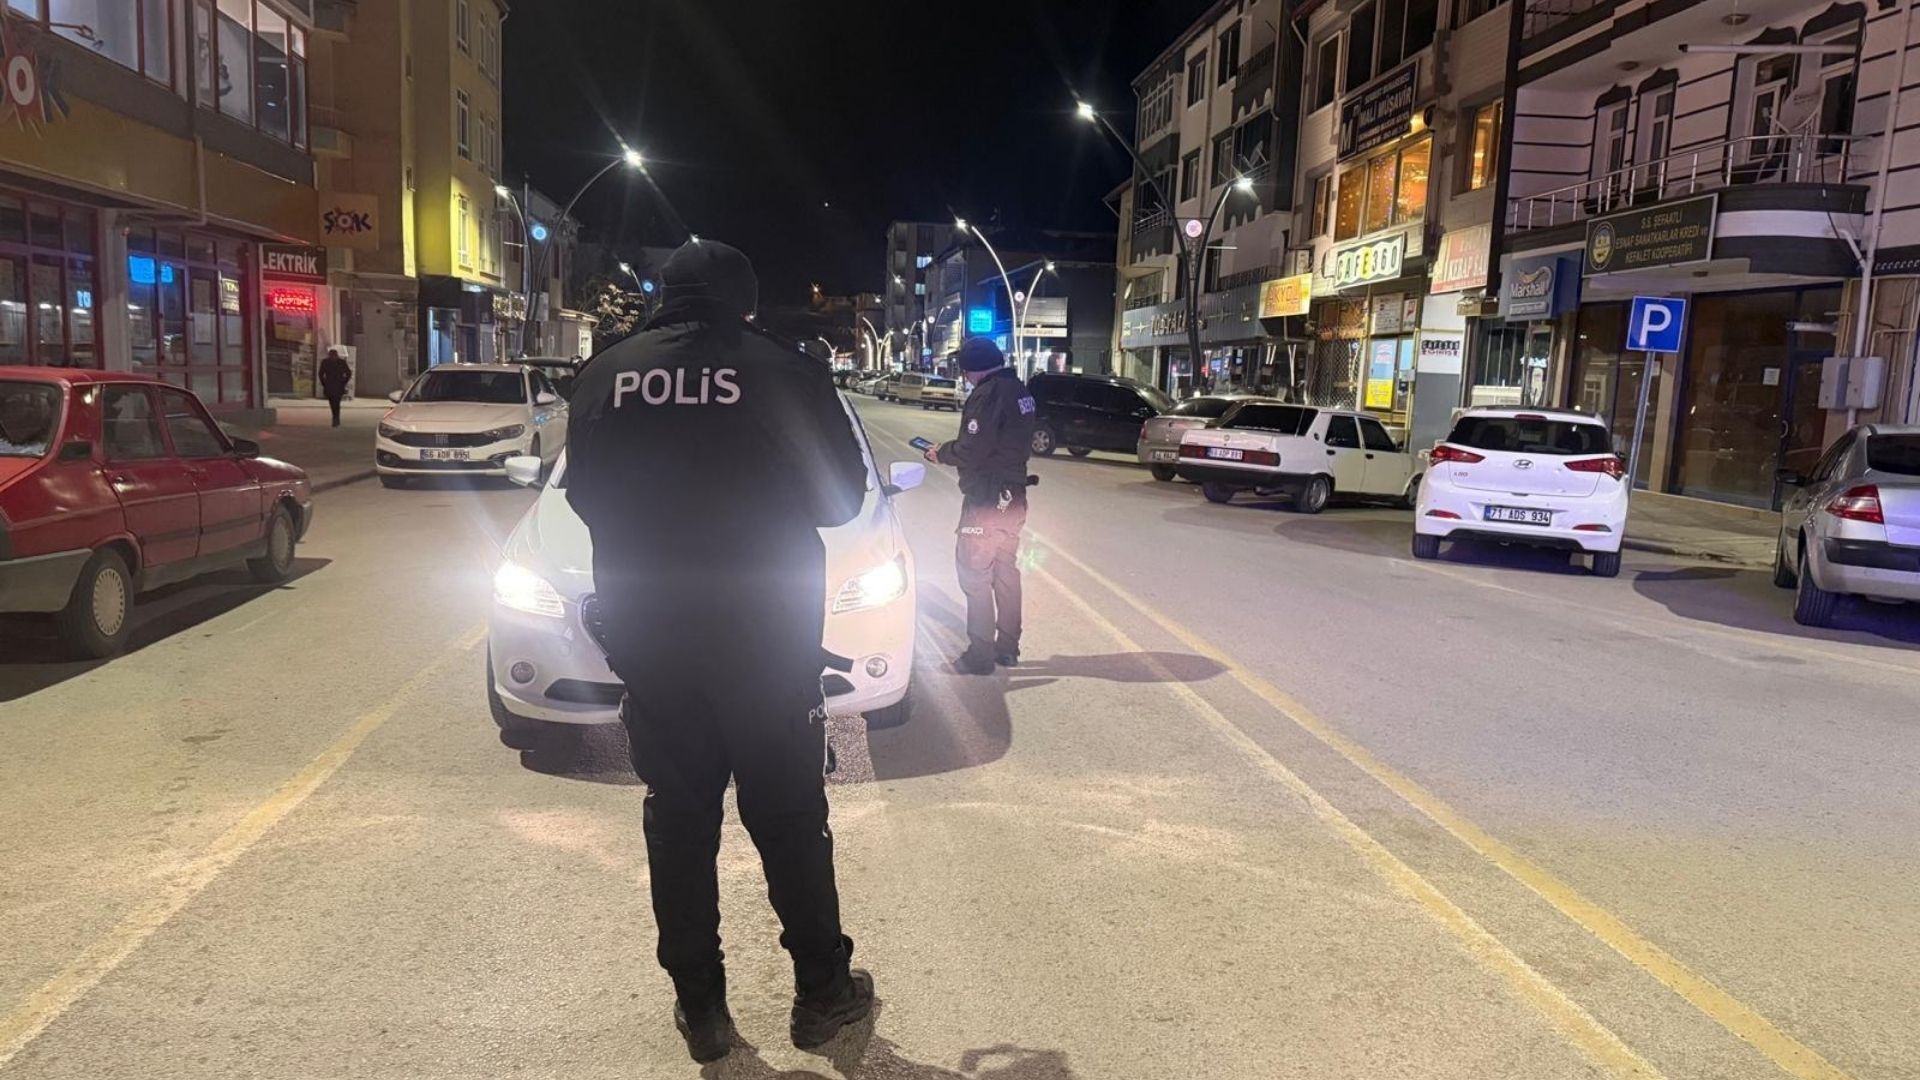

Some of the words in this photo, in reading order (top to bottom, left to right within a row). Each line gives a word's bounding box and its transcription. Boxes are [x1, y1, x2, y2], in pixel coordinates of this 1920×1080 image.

[323, 209, 372, 235] ŞOK
[1510, 281, 1546, 298] Marshall
[1639, 304, 1671, 345] P
[1490, 506, 1502, 518] 71
[1508, 508, 1526, 520] ADS
[1531, 510, 1549, 522] 934
